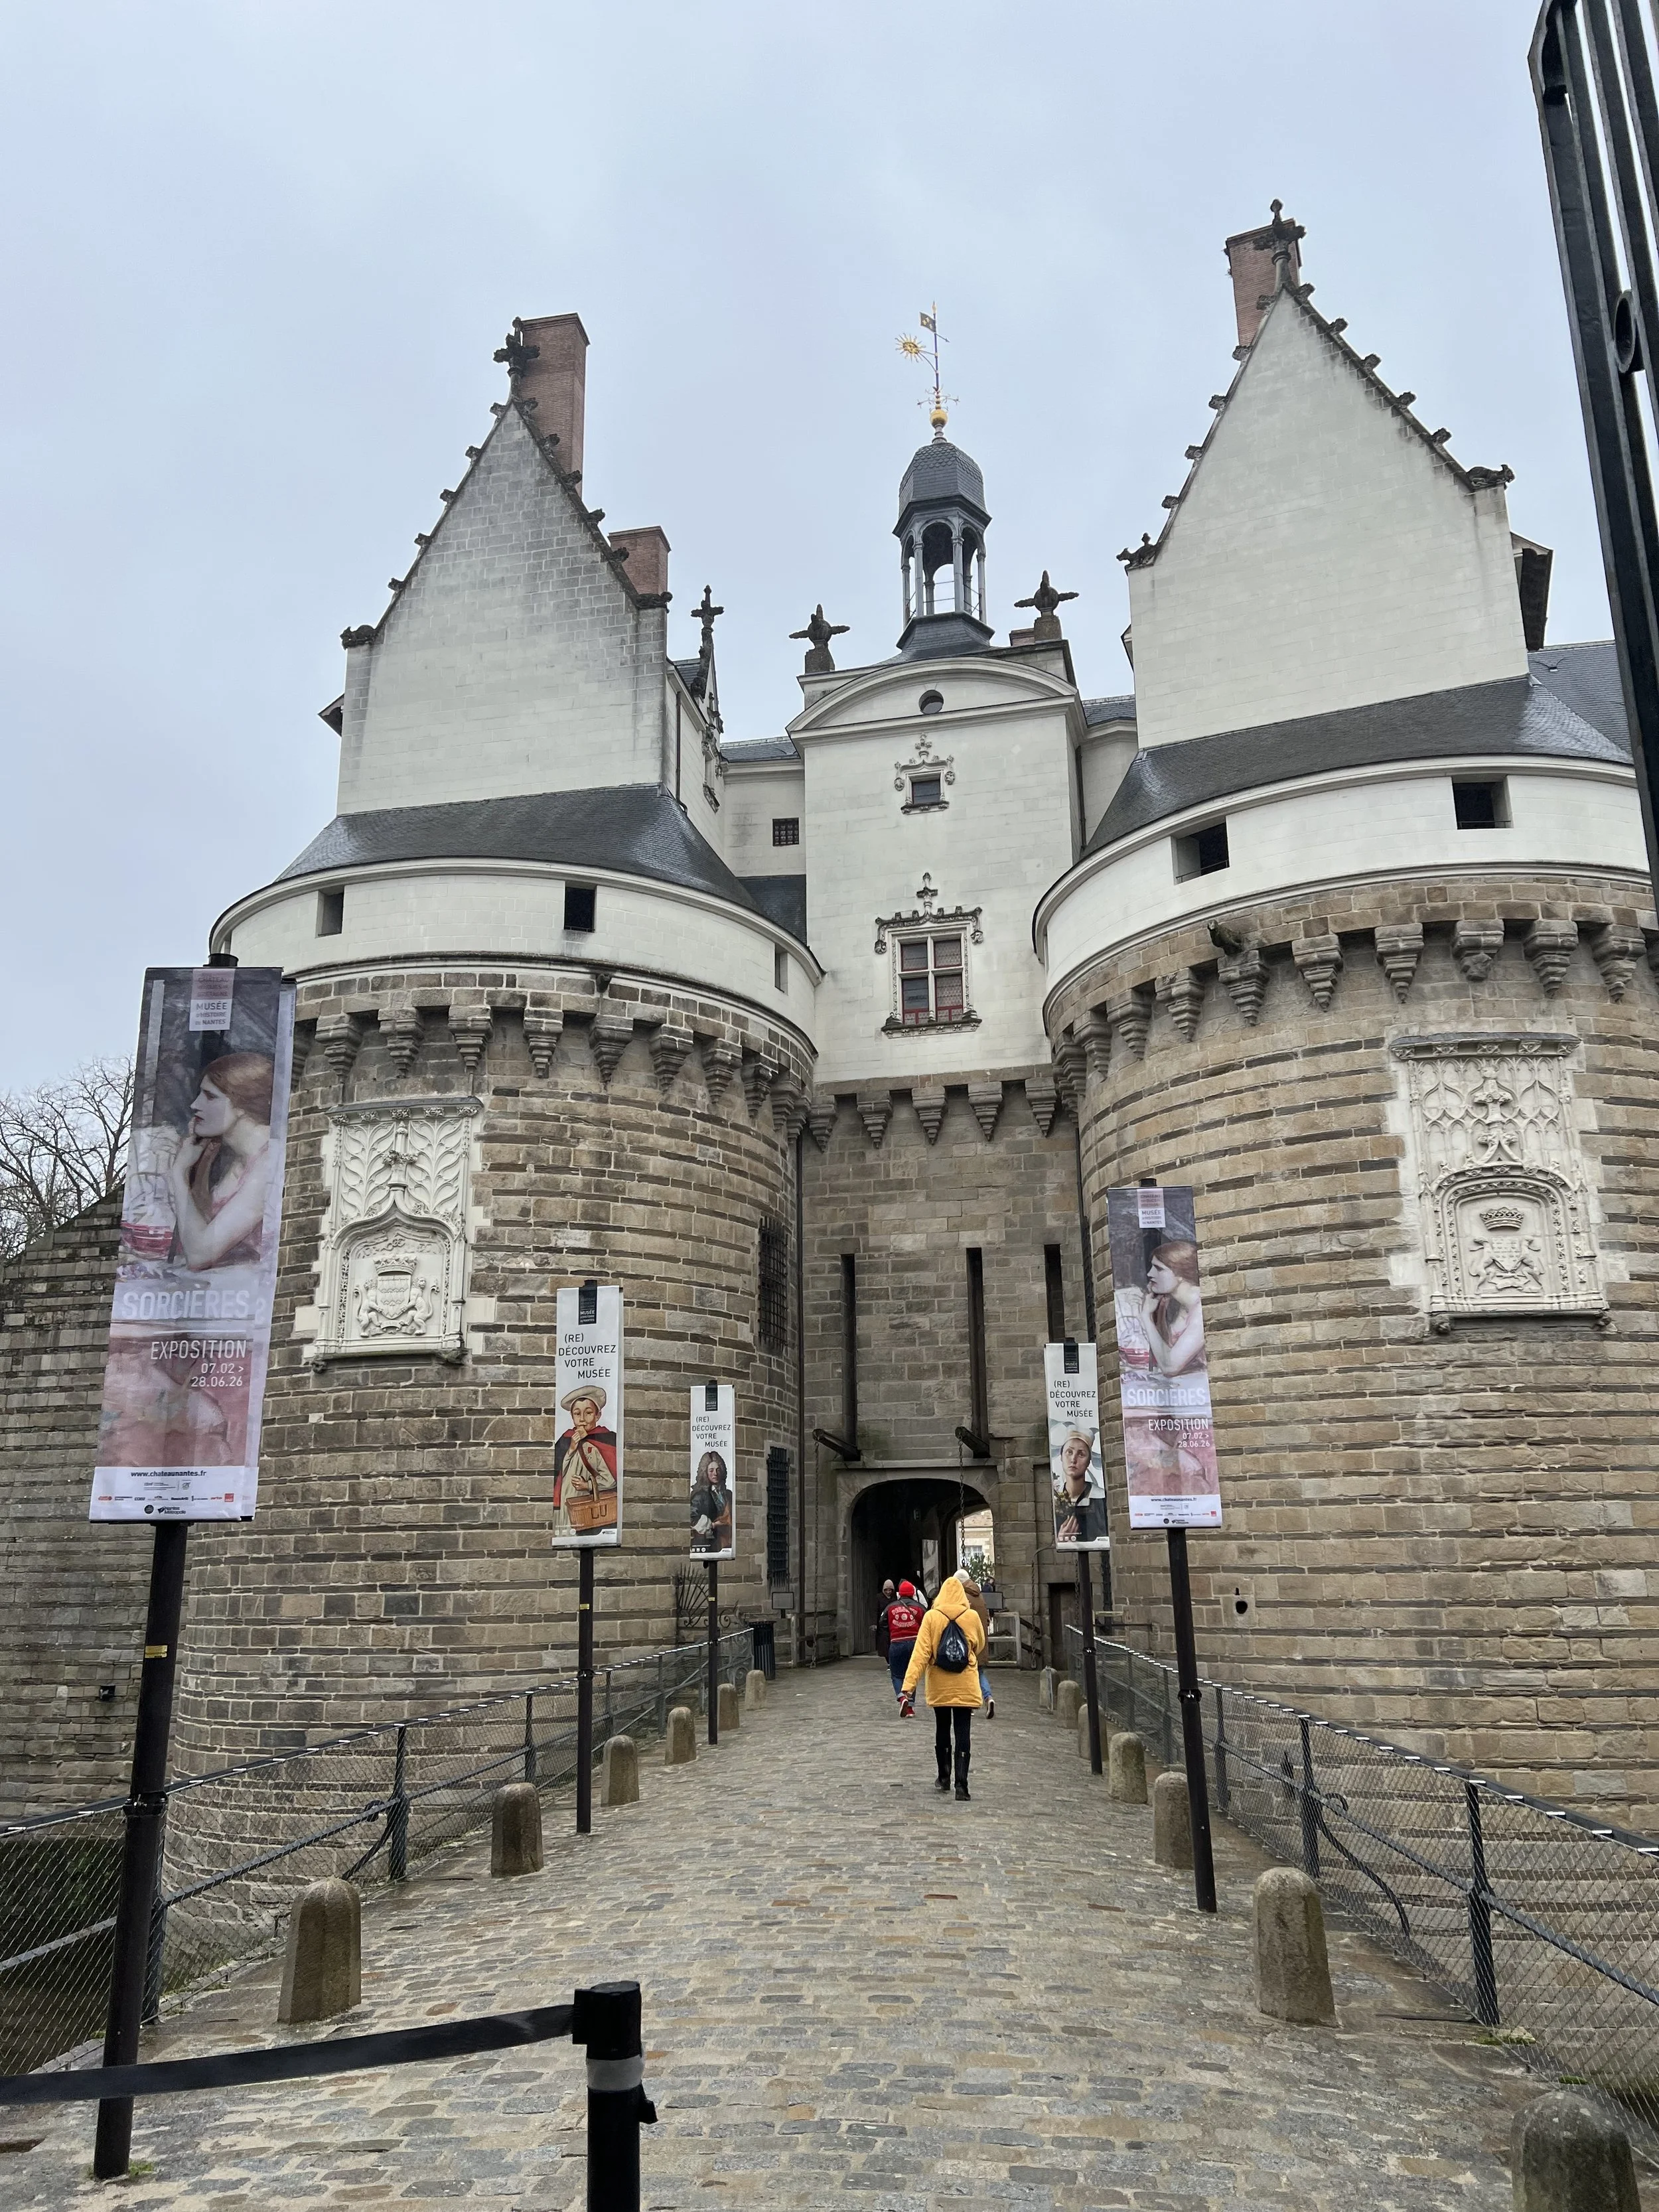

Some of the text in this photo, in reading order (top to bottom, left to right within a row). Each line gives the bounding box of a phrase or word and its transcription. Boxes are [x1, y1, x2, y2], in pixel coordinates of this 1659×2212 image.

[196, 1001, 228, 1010] MUSÉE
[564, 1333, 584, 1343] (RE)
[150, 1340, 247, 1360] EXPOSITION
[558, 1345, 616, 1356] DÉCOUVREZ
[201, 1363, 234, 1374] 07.02
[565, 1358, 595, 1368] VOTRE
[578, 1367, 611, 1379] MUSÉE
[190, 1376, 243, 1387] 28.06.26
[1050, 1390, 1096, 1398] DÉCOUVREZ
[1066, 1408, 1093, 1417] MUSÉE
[1148, 1418, 1208, 1431] EXPOSITION
[591, 1503, 607, 1519] LU
